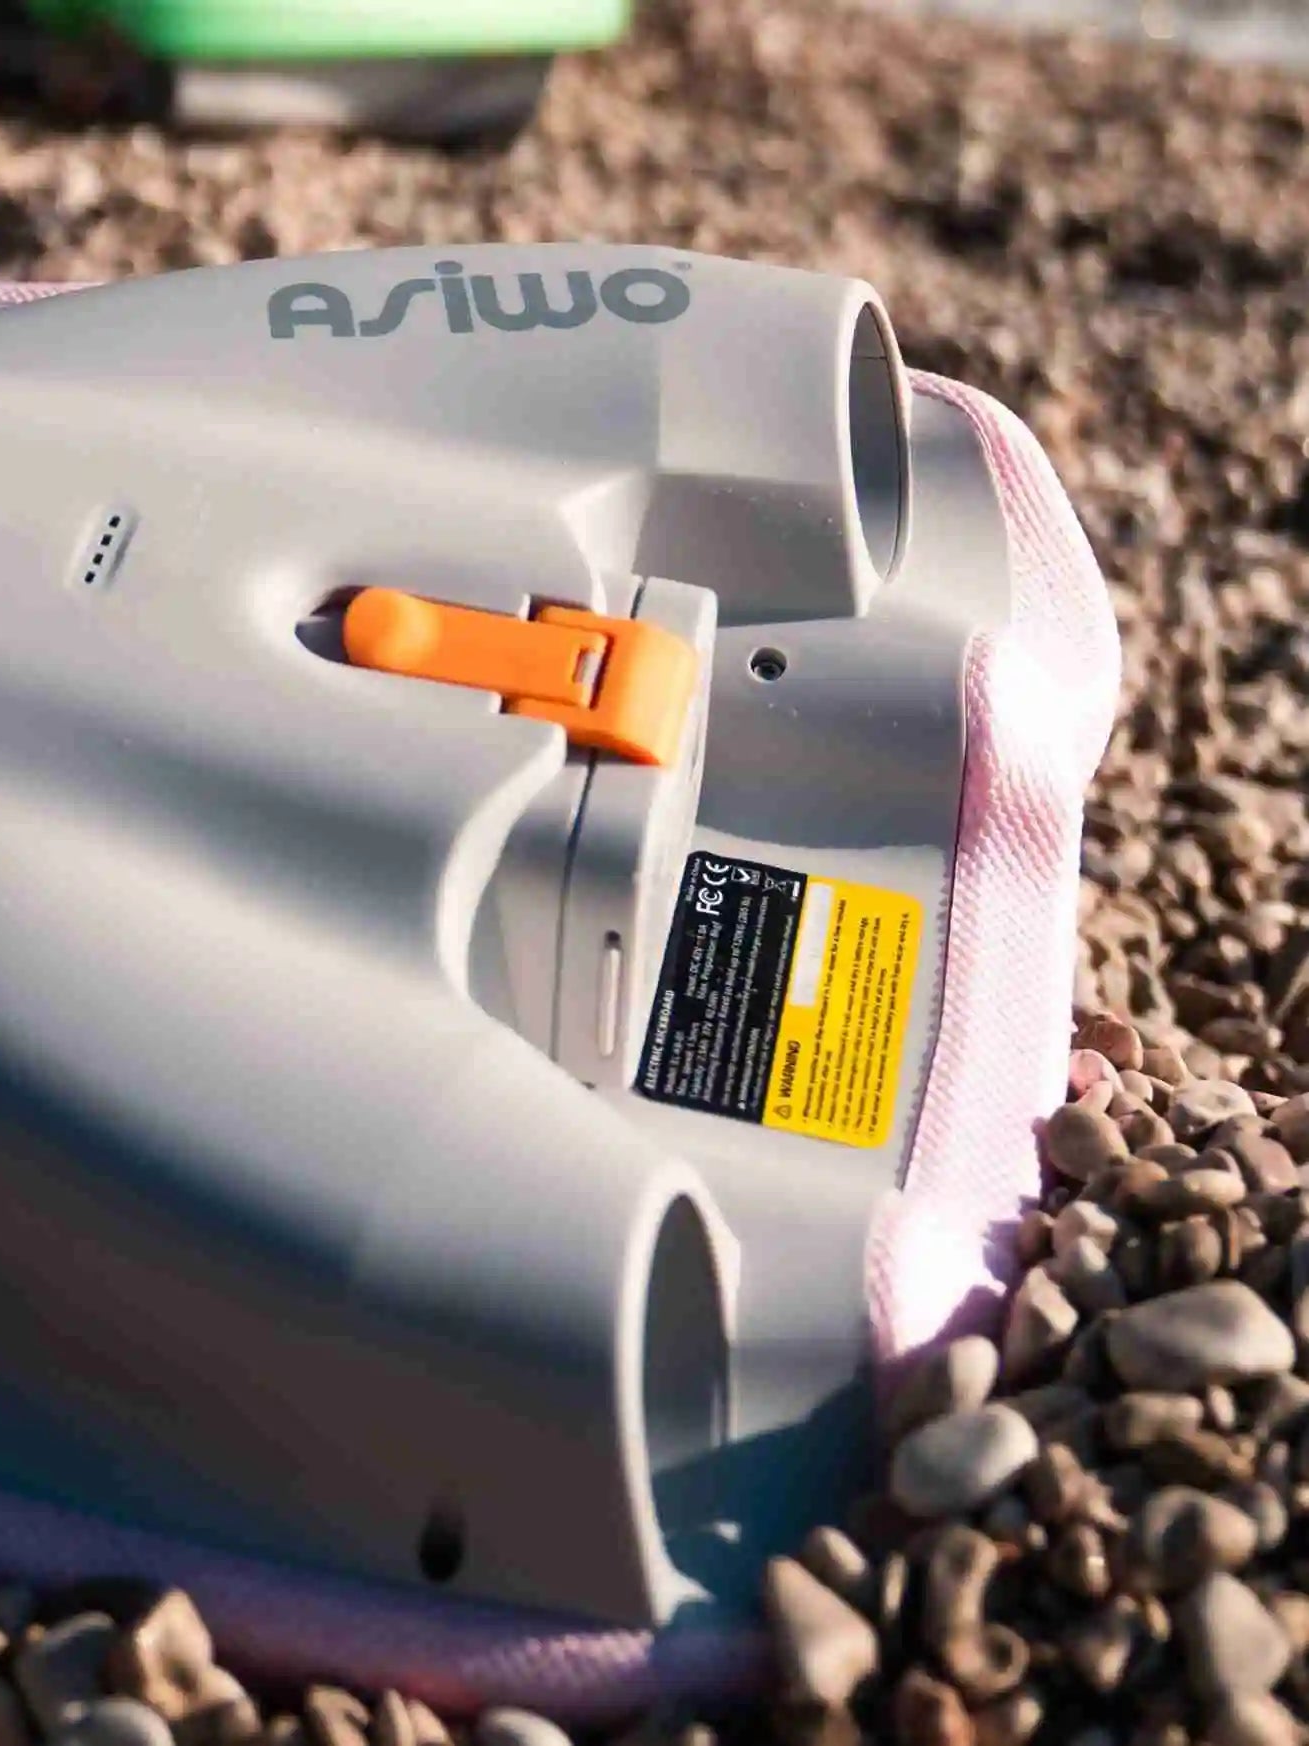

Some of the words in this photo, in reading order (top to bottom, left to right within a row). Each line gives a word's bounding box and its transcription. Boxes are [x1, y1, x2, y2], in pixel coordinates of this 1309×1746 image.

[704, 859, 729, 887] CE
[644, 1044, 664, 1089] ELECTRIC
[655, 990, 675, 1043] KICKBOARD
[777, 1040, 800, 1098] WARNING
